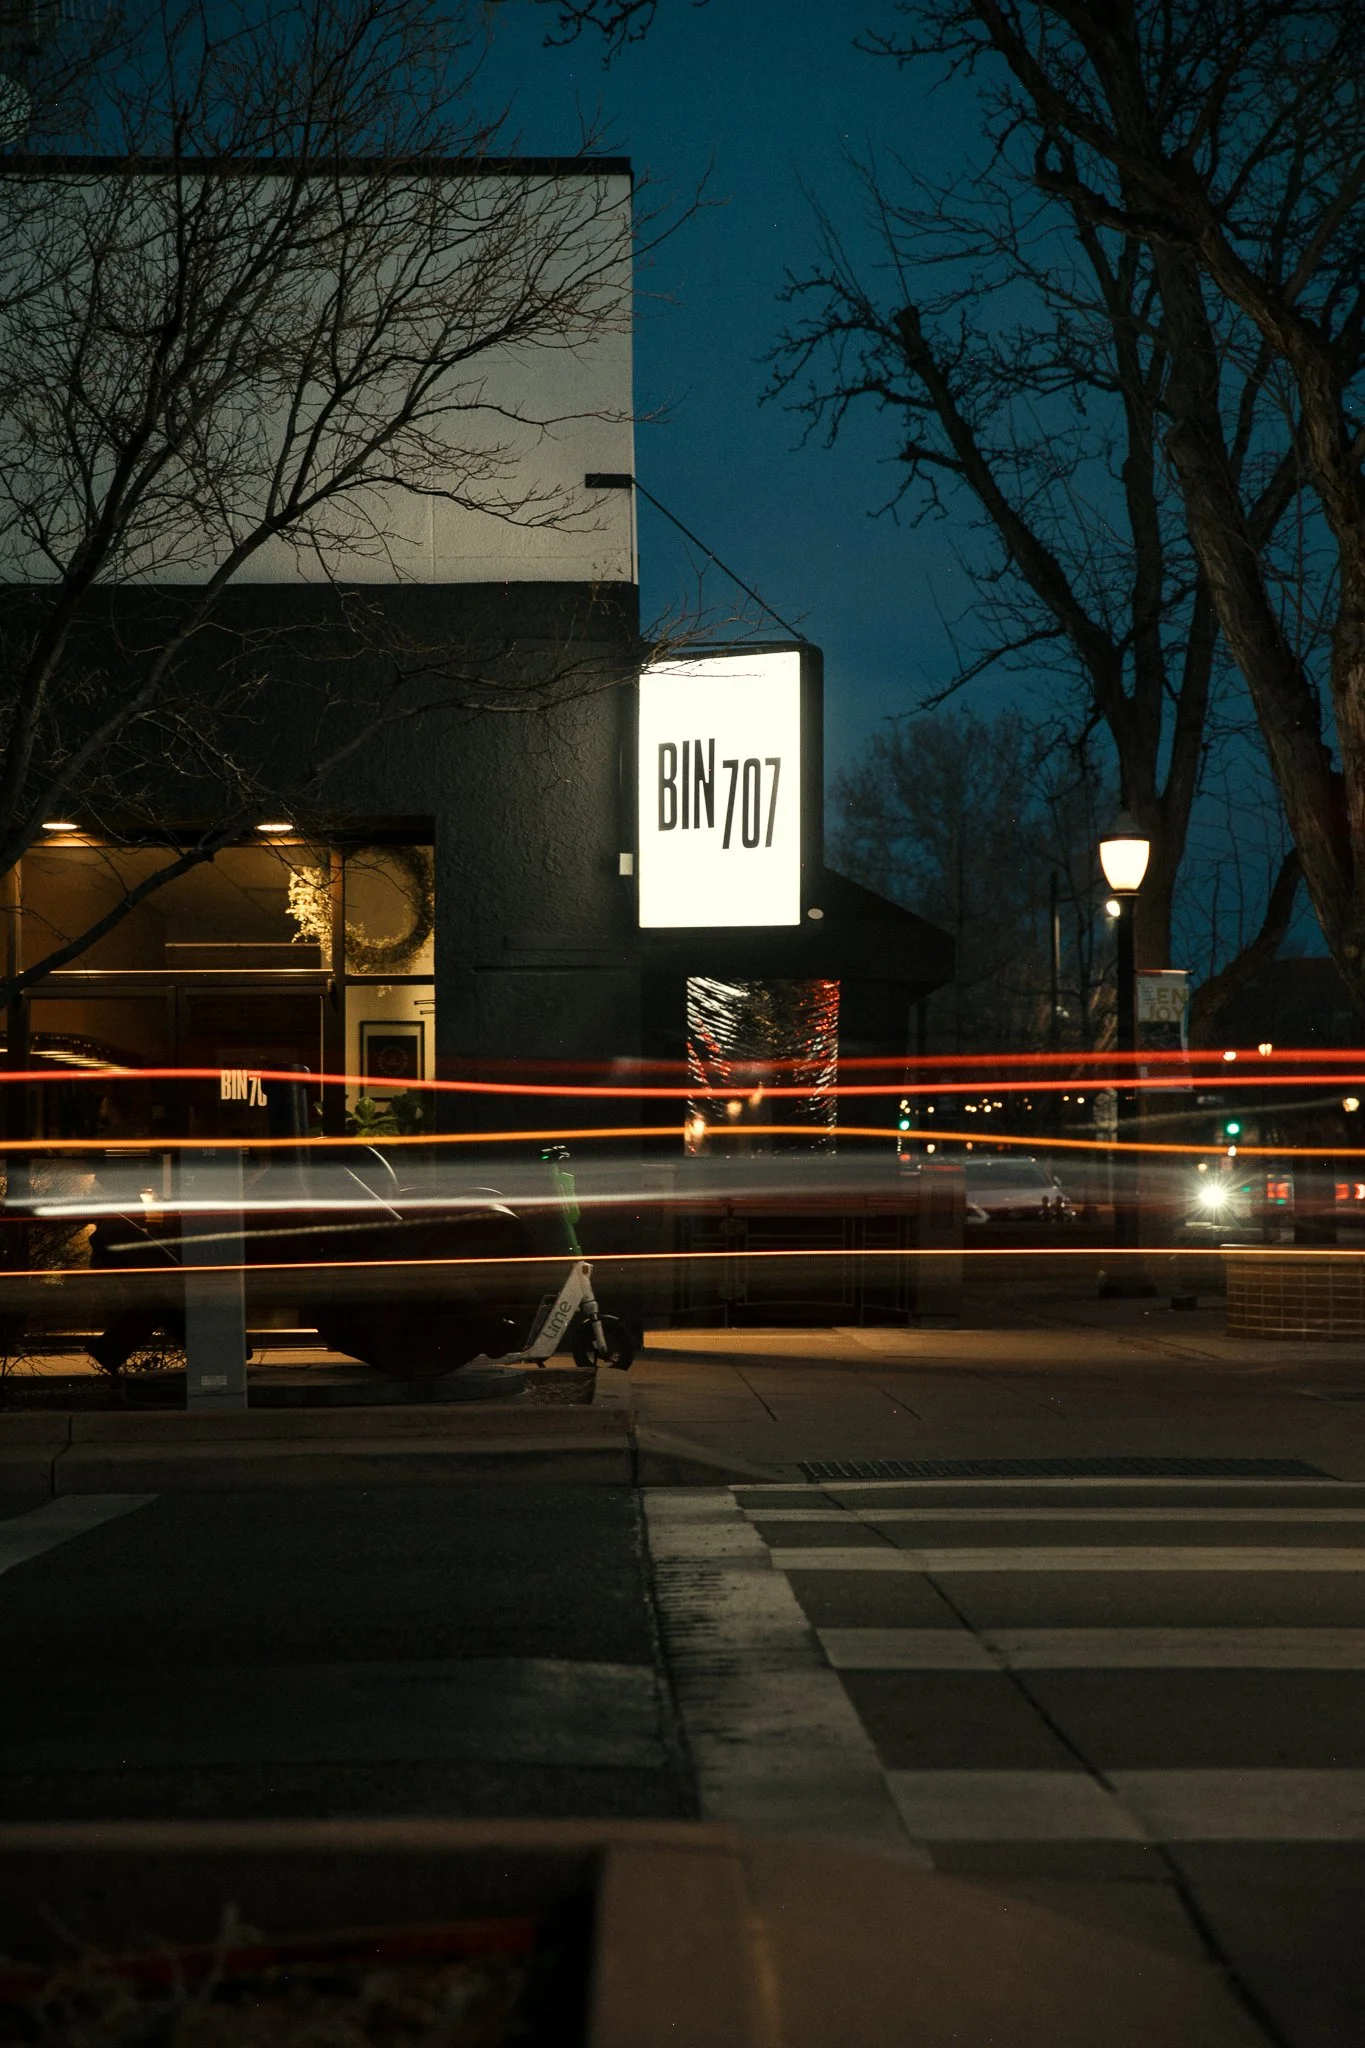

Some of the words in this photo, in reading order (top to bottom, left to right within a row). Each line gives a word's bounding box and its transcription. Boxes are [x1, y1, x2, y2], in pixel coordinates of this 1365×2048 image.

[658, 738, 715, 831] BIN
[722, 757, 781, 849] 707
[220, 1069, 248, 1100] BIN
[542, 1301, 571, 1339] Lime
